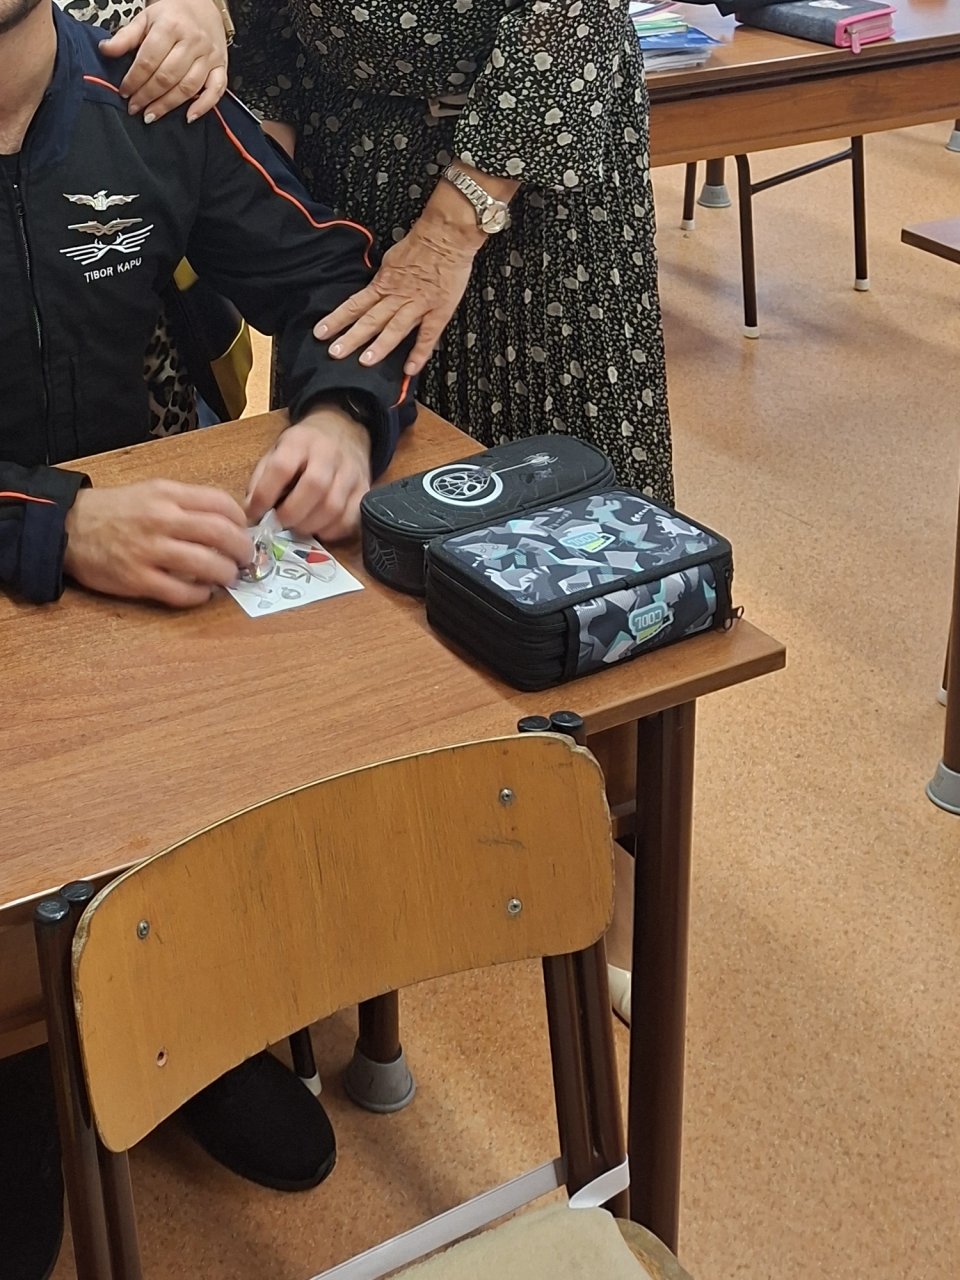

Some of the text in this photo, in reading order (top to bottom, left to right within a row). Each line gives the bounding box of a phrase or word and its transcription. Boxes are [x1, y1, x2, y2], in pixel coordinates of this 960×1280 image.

[84, 257, 142, 283] TIBOR KAPU
[634, 609, 663, 629] COOL
